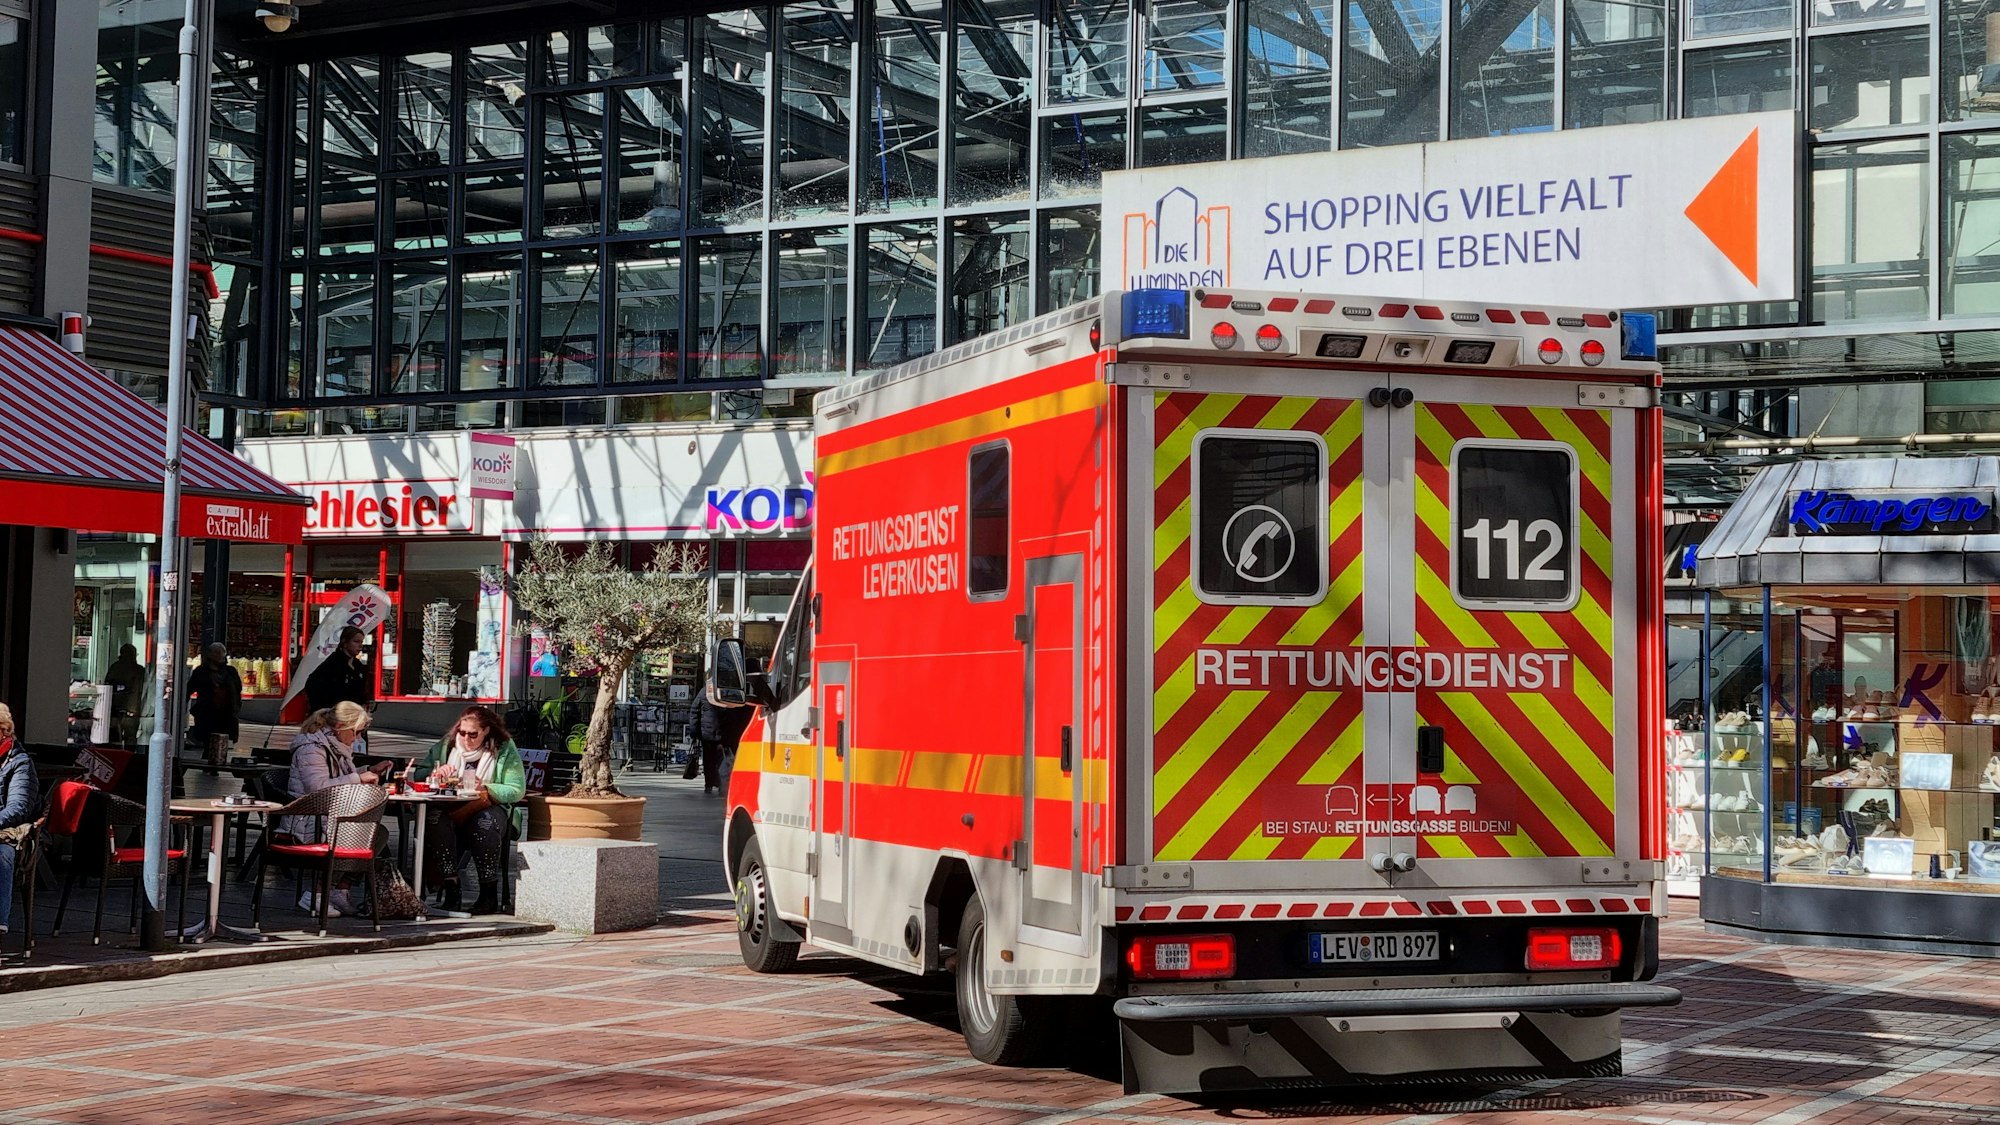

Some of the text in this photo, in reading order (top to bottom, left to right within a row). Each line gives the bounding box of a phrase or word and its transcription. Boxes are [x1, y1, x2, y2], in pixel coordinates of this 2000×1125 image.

[1264, 174, 1633, 235] SHOPPING VIELFALT
[1164, 242, 1188, 264] DIE
[1263, 226, 1581, 281] AUF DREI EBENEN
[477, 476, 507, 485] WIESDORF
[206, 507, 272, 540] extrablatt
[302, 485, 457, 529] chlesier
[706, 487, 815, 531] KOD
[1789, 490, 1990, 533] Kämpgen
[833, 505, 959, 561] RETTUNGSDIENST
[1463, 518, 1565, 581] 112
[863, 552, 959, 600] LEVERKUSEN
[1196, 649, 1568, 689] RETTUNGSDIENST
[1266, 820, 1511, 834] BEI STAU: RETTUNGSGASSE BILDEN!
[1323, 936, 1359, 960] LEV
[1374, 935, 1398, 958] RD
[1403, 934, 1437, 958] 897
